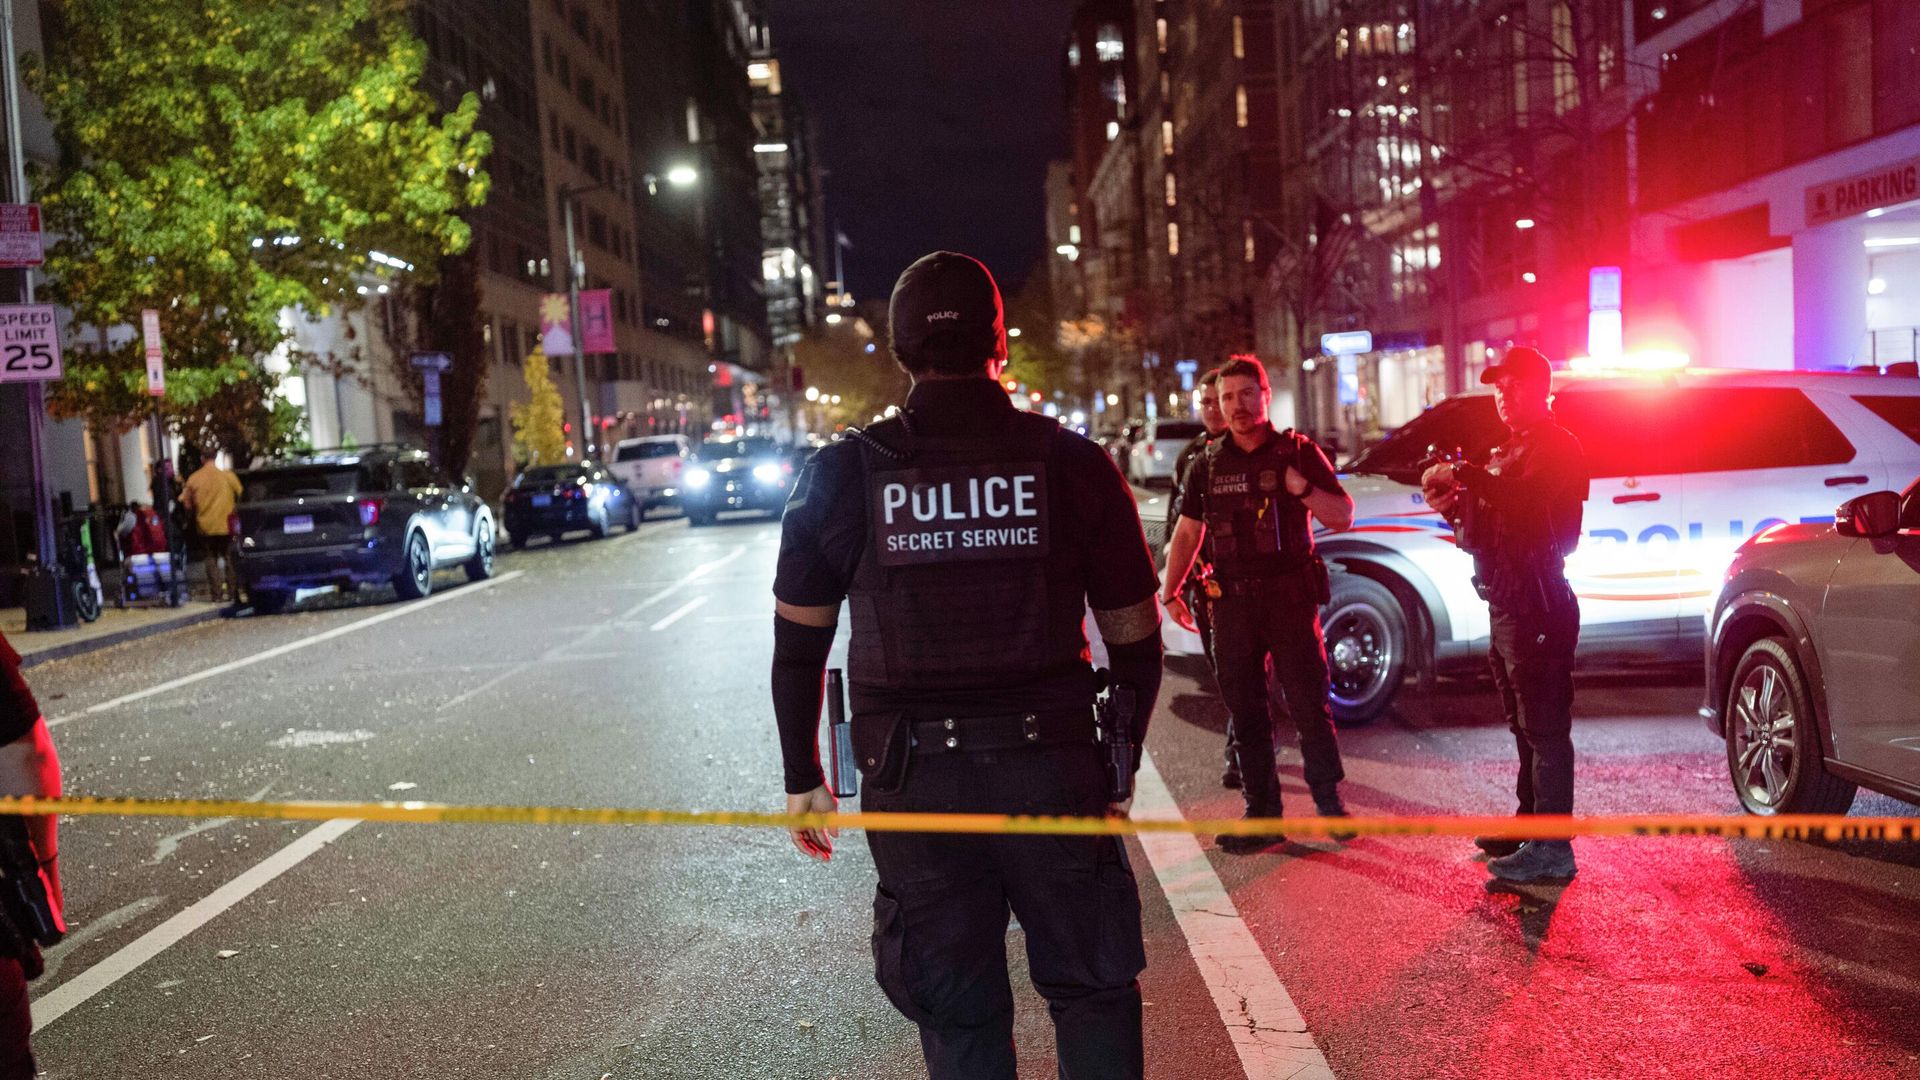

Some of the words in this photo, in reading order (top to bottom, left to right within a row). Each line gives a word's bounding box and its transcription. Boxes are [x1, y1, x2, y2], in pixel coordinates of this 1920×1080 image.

[1836, 165, 1916, 212] PARKING
[0, 312, 52, 326] SPEED
[926, 310, 960, 323] POLICE
[5, 328, 46, 341] LIMIT
[4, 344, 53, 371] 25
[1212, 482, 1248, 494] SERVICE
[883, 475, 1038, 525] POLICE
[887, 531, 955, 552] SECRET
[962, 527, 1039, 549] SERVICE
